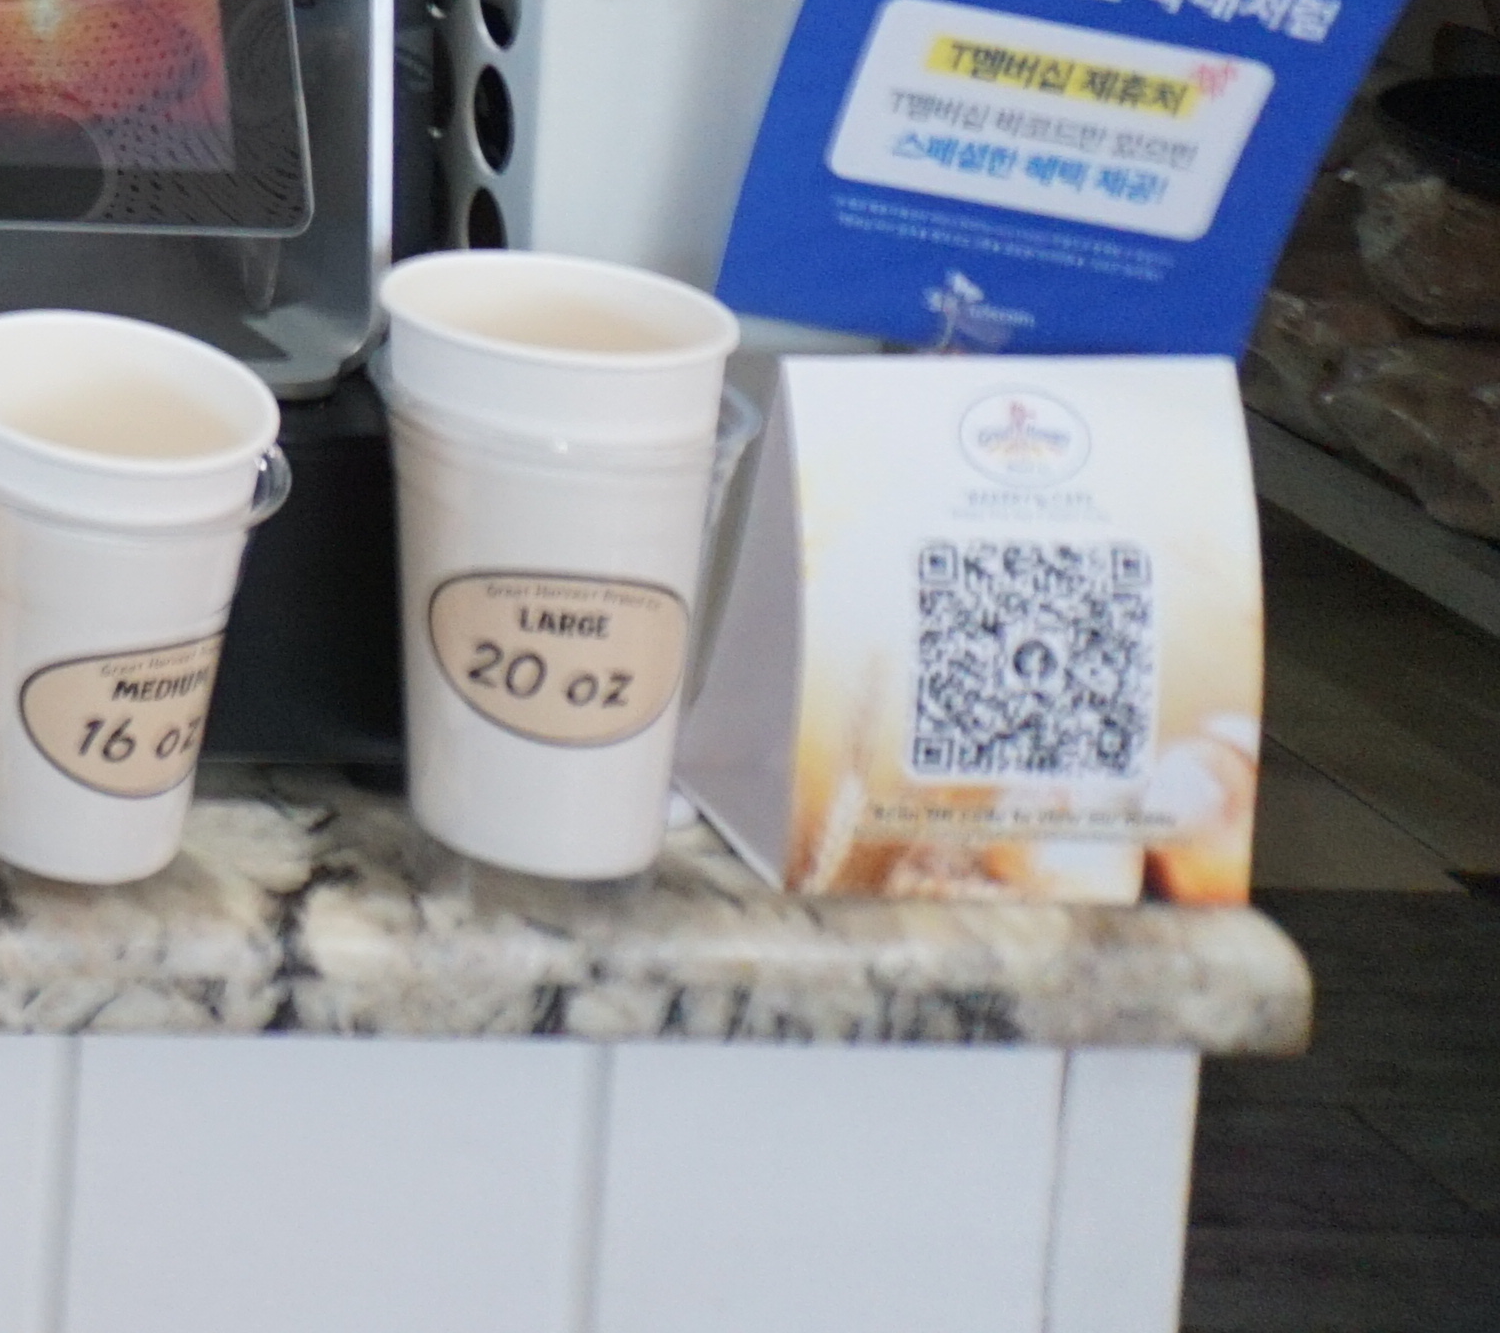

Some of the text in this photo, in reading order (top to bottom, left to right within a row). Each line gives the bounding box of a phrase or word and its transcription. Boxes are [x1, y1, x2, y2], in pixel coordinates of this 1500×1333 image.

[519, 607, 614, 641] LARGE
[467, 638, 548, 700] 20
[77, 716, 138, 765] 16
